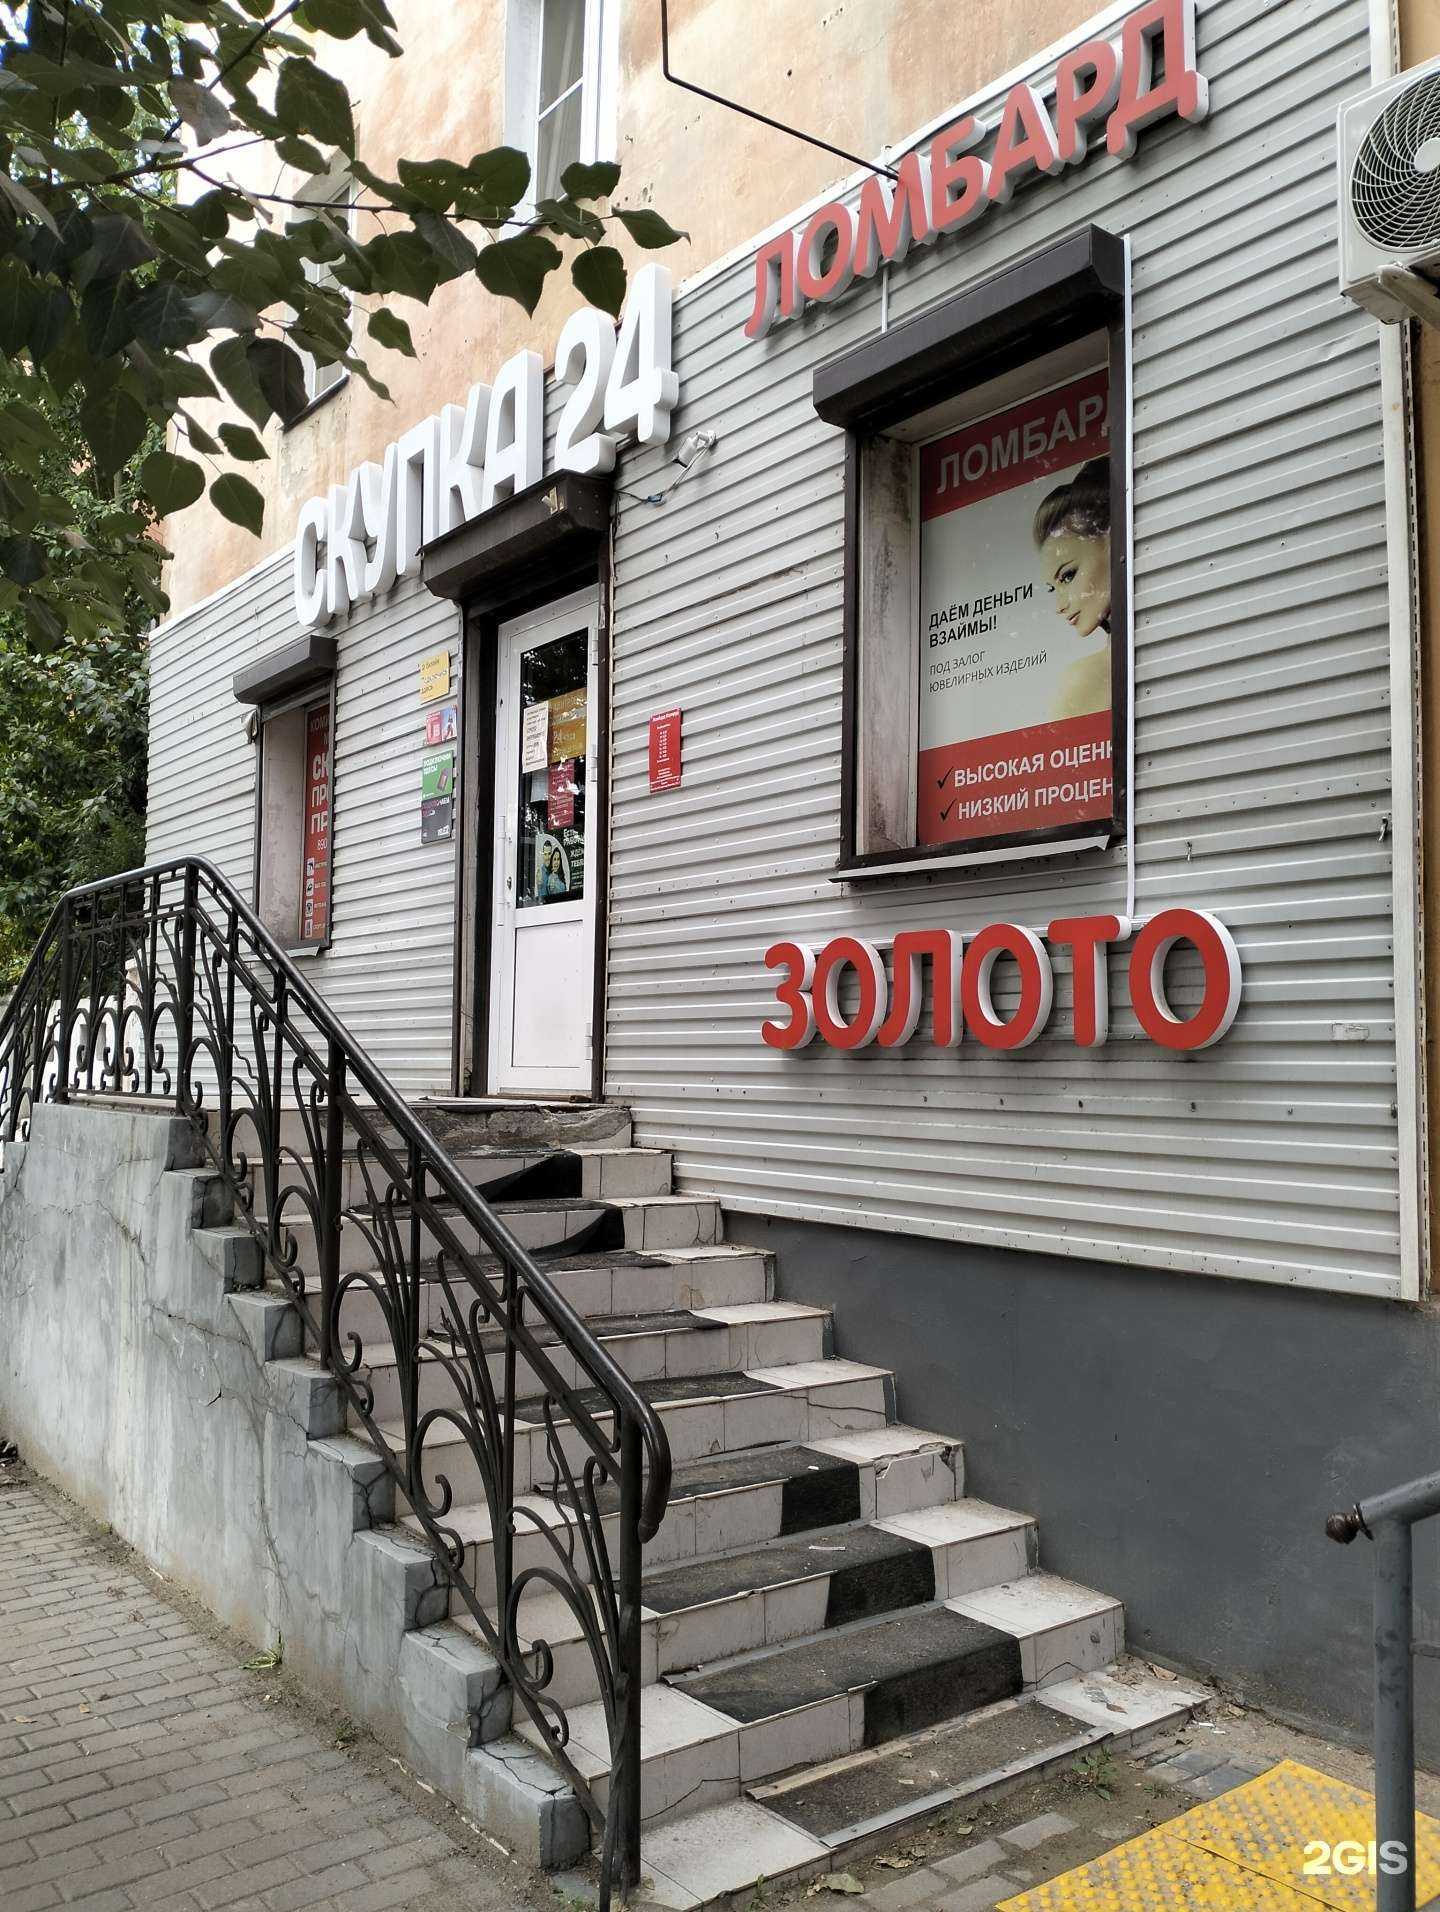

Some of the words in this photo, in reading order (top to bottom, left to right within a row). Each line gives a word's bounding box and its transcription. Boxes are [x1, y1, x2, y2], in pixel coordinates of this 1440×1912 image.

[744, 0, 1209, 340] ЛОМБАРД
[294, 349, 544, 628] СКУПКА
[554, 262, 679, 475] 24
[929, 603, 970, 631] ДАЁМ
[972, 583, 1033, 618] ДЕНЬГИ
[929, 615, 998, 649] ВЗАЙМЫ!
[929, 659, 951, 676] ПОД
[952, 651, 985, 671] ЗАЛОГ
[929, 667, 994, 694] ЮВЕЛИРНЫХ
[996, 650, 1048, 678] ИЗДЕЛИЙ
[954, 753, 1045, 788] ВЫСОКАЯ
[958, 787, 1029, 820] НИЗКИЙ
[761, 908, 1242, 1050] ЗОЛОТО
